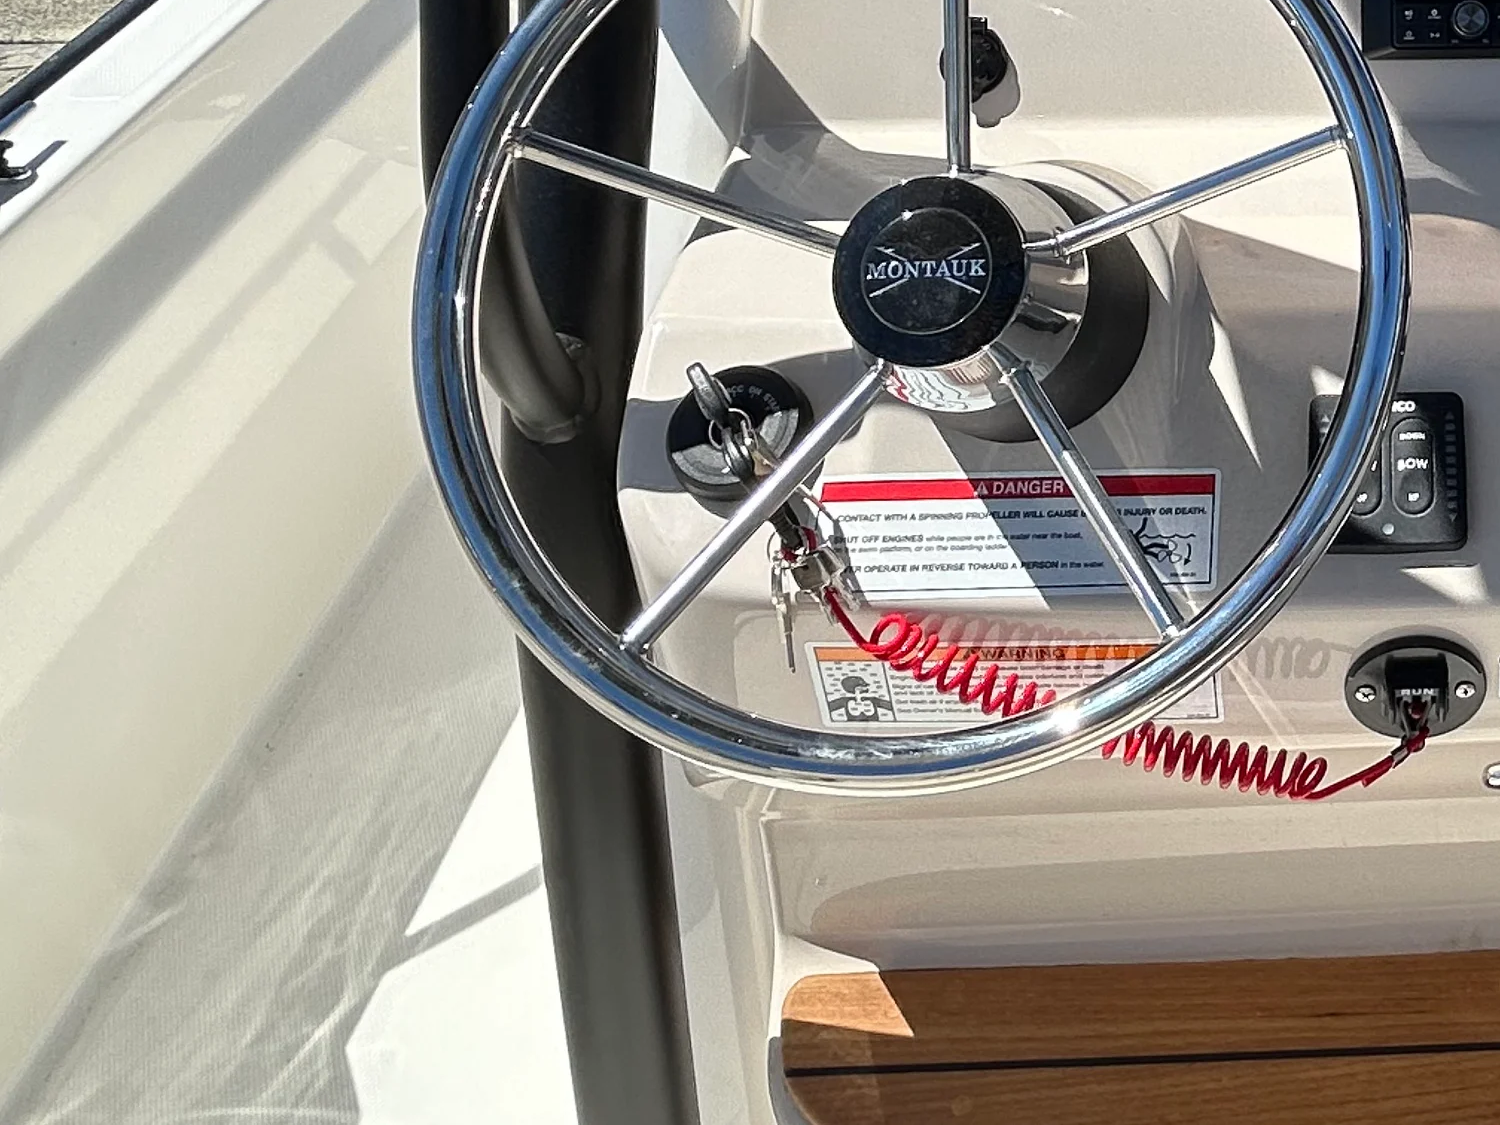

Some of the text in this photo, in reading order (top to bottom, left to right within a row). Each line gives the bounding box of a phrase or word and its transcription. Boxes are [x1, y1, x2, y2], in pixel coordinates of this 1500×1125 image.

[866, 259, 986, 279] MONTAUK
[1398, 458, 1428, 471] BOW
[993, 480, 1064, 495] DANGER
[837, 514, 882, 522] CONTACT
[884, 513, 908, 521] WITH
[909, 513, 916, 521] A
[918, 512, 964, 520] SPINNING
[1022, 509, 1044, 518] WILL
[1047, 509, 1079, 518] CAUSE
[1124, 507, 1157, 516] INJURY
[1159, 507, 1173, 515] OR
[861, 535, 880, 543] OFF
[882, 534, 923, 543] ENGINES
[864, 564, 907, 573] OPERATE
[909, 564, 920, 572] IN
[922, 563, 965, 572] REVERSE
[967, 562, 1009, 571] TOWARD
[1020, 561, 1059, 569] PERSON
[982, 647, 1065, 662] WARNING
